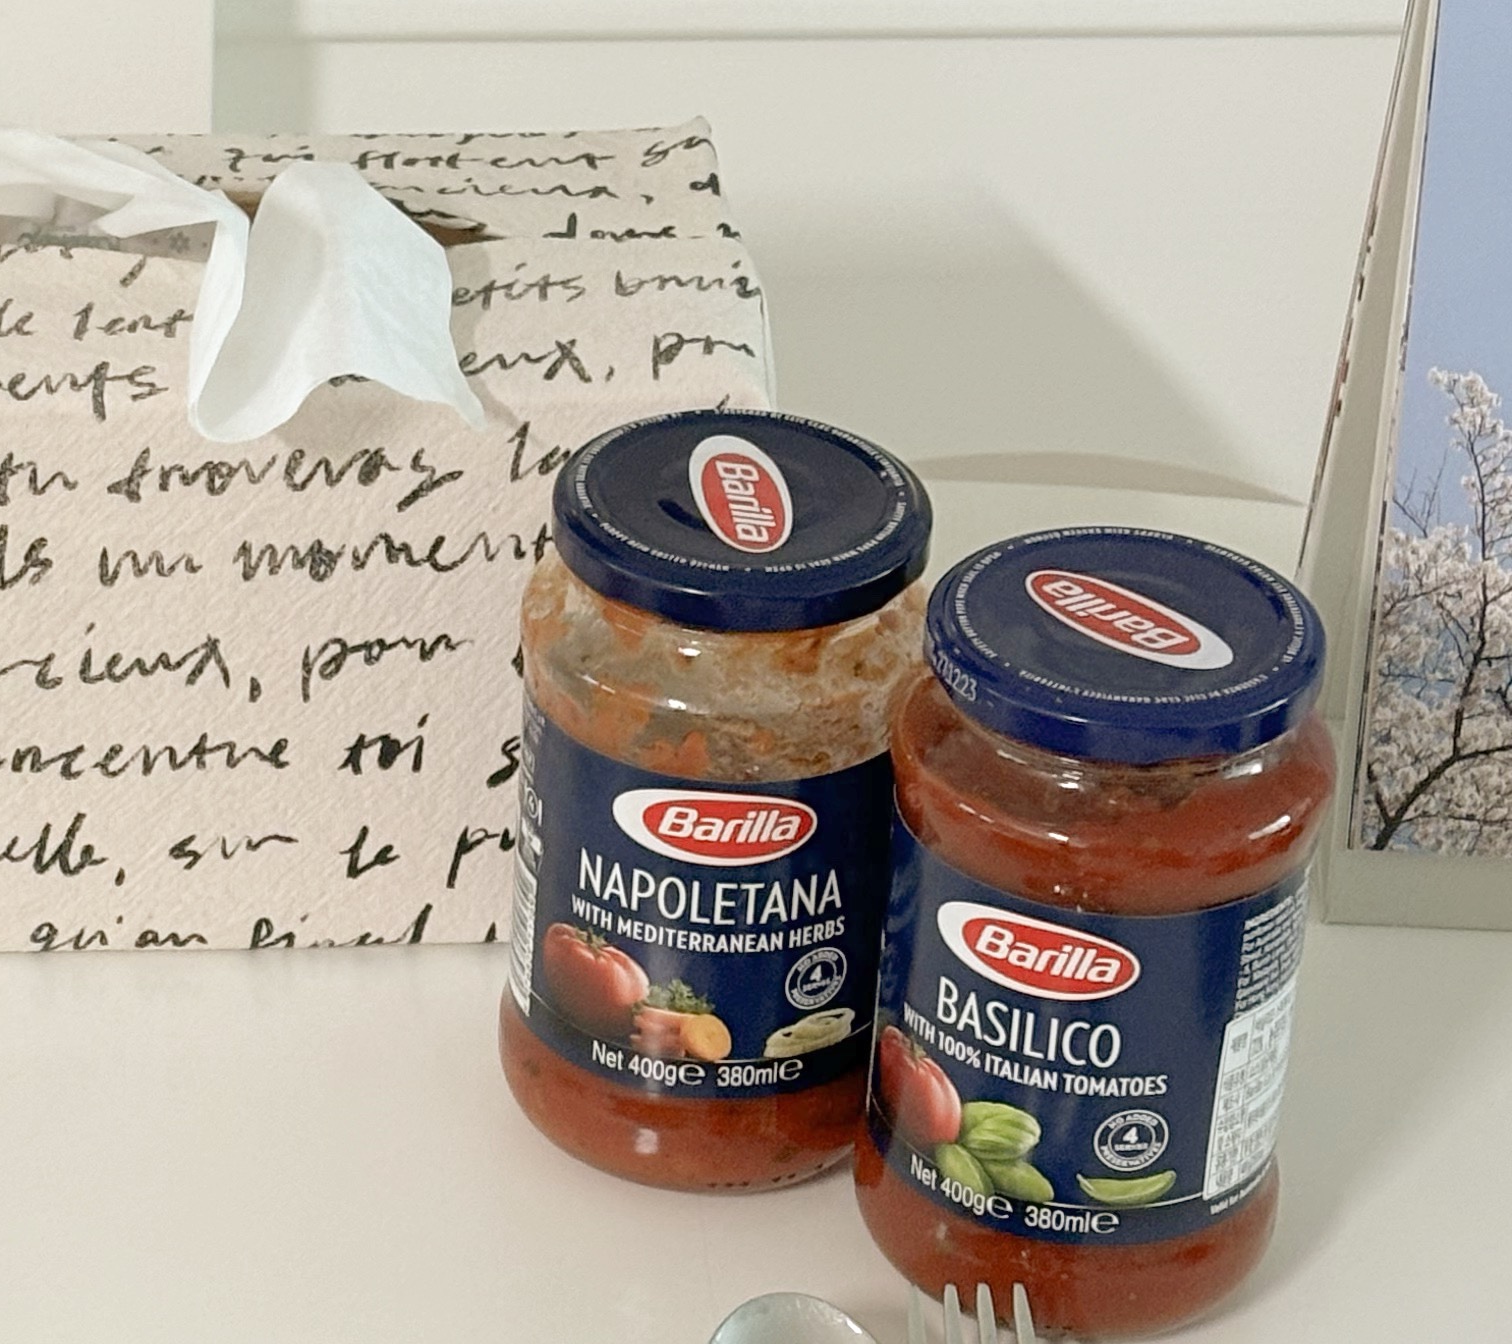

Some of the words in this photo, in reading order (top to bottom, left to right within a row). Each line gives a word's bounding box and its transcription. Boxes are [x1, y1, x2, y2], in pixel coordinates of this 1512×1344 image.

[714, 460, 778, 544] Barilla
[1041, 579, 1190, 652] Barilla
[658, 806, 801, 843] Barilla
[578, 847, 842, 925] NAPOLETANA
[571, 893, 613, 932] WITH
[616, 915, 784, 953] MEDITERRANEAN
[788, 916, 845, 949] HERBS
[975, 924, 1121, 983] Barilla
[903, 1001, 936, 1045] WITH
[938, 1030, 981, 1070] 100%
[984, 1053, 1058, 1092] ITALIAN
[1063, 1073, 1168, 1099] TOMATOES
[937, 975, 1121, 1068] BASILICO
[592, 1040, 624, 1071] Net
[1122, 1126, 1139, 1144] 4
[910, 1154, 937, 1190] Net
